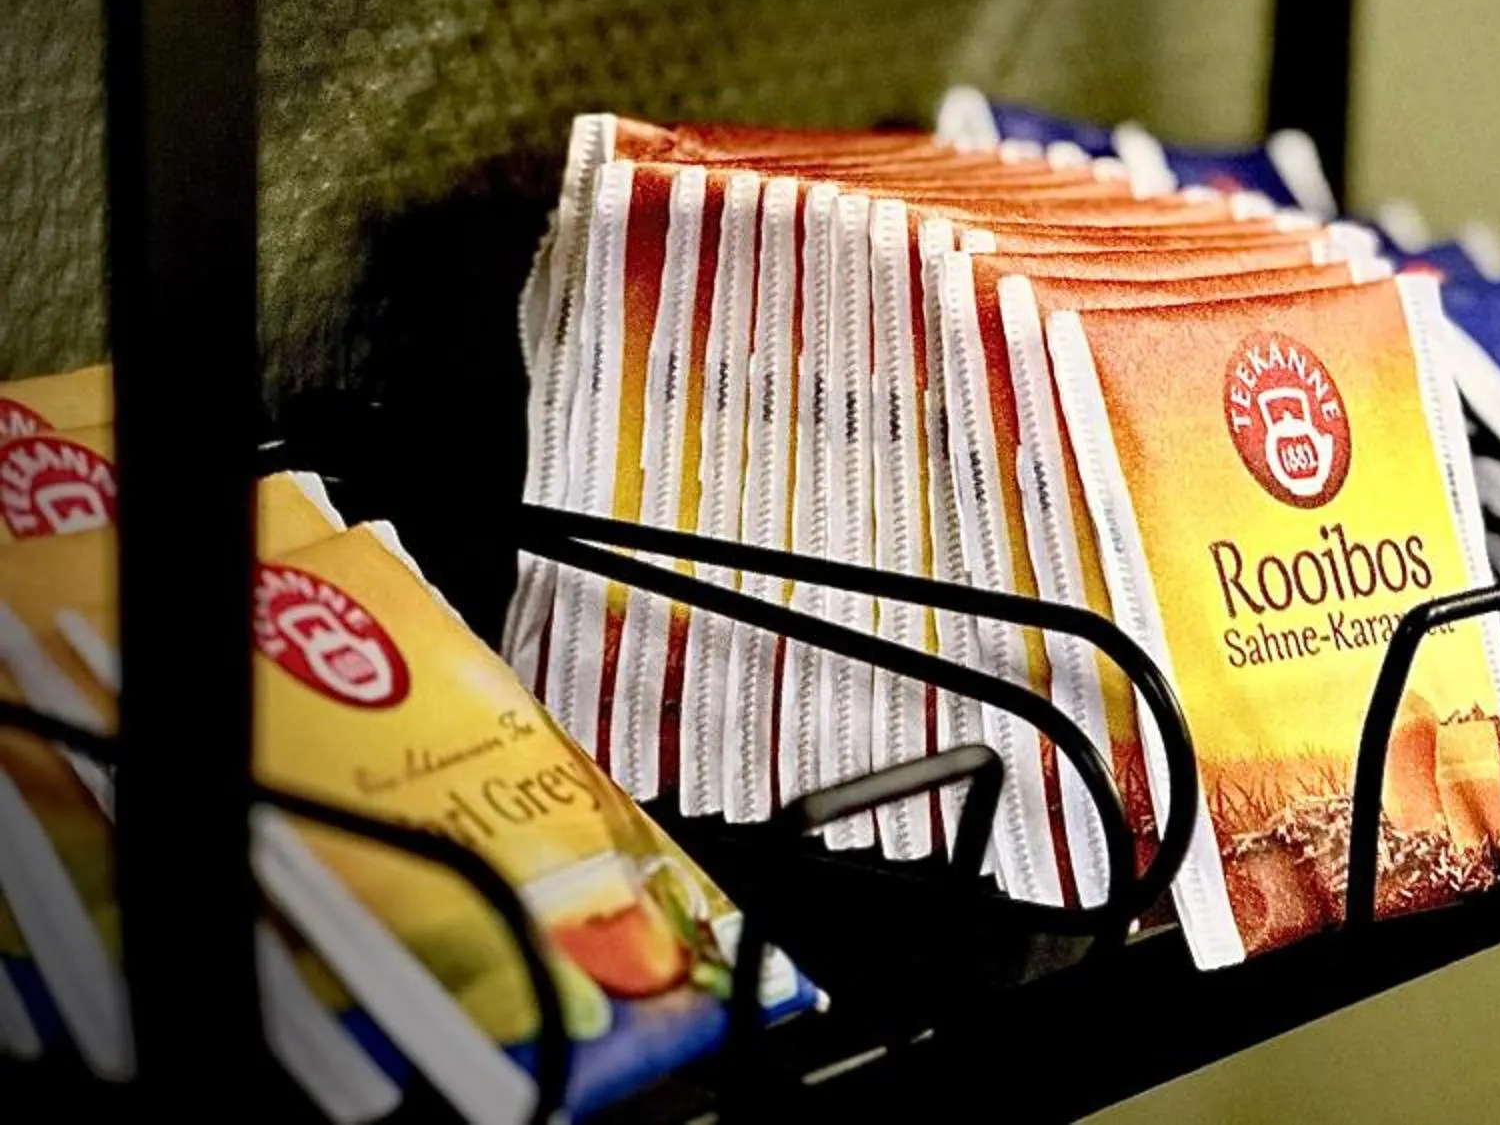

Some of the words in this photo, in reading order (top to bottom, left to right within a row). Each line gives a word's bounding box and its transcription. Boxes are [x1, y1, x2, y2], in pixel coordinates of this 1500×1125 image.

[1231, 340, 1340, 433] TEEKANNE
[1209, 523, 1432, 618] Rooibos
[1223, 608, 1455, 668] Sahne-Kara
[482, 759, 601, 825] Grey
